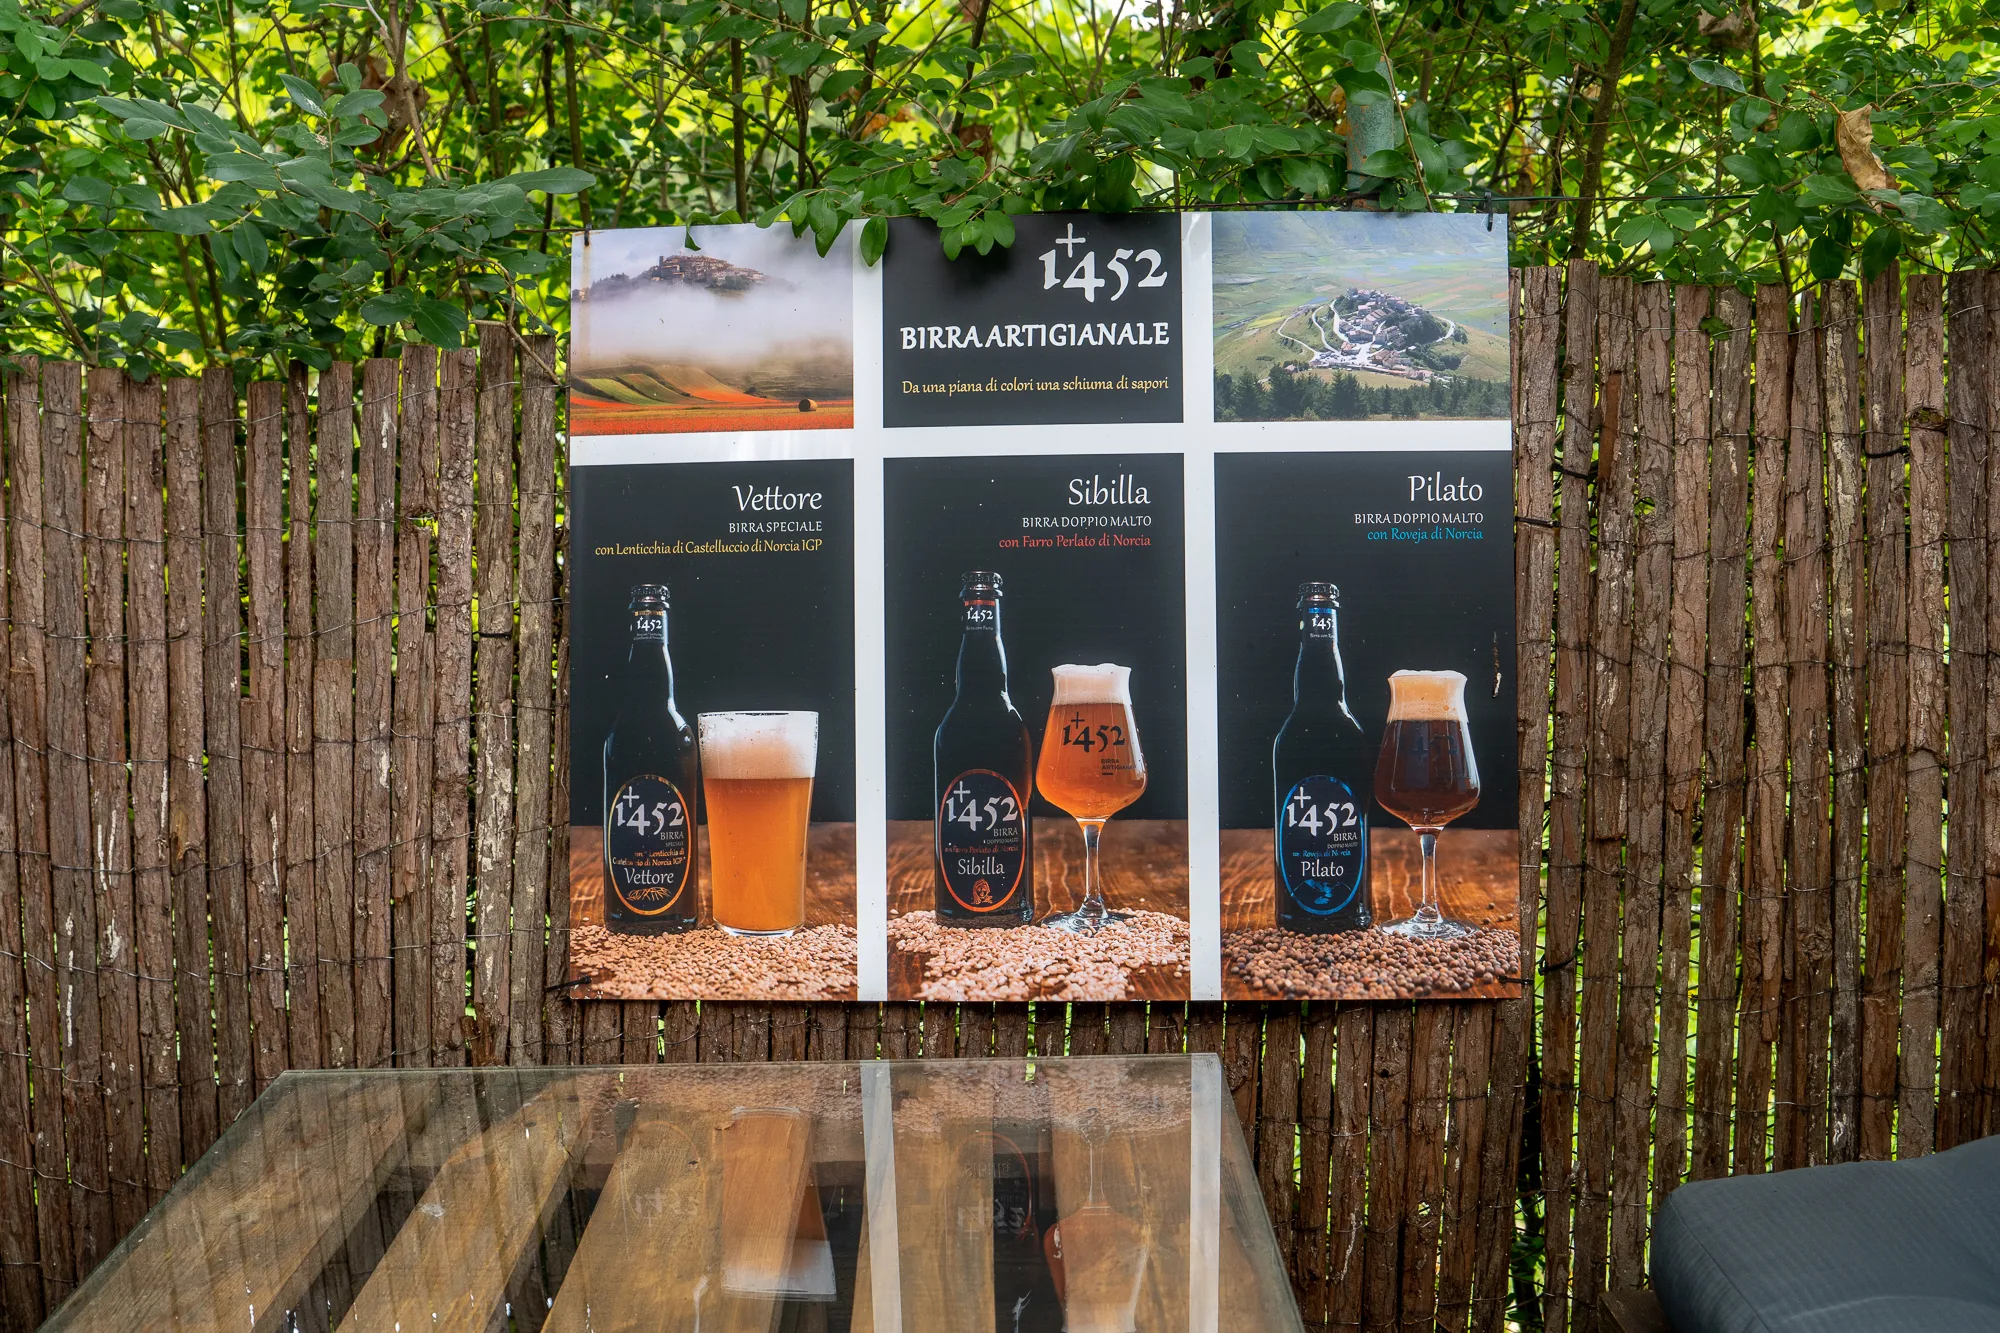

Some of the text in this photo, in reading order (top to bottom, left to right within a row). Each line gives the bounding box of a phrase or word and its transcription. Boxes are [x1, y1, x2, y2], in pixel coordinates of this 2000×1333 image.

[1038, 248, 1168, 303] 1452
[900, 322, 1170, 350] BIRRA ARTIGIANALE
[902, 375, 1169, 396] Da una piana di colori una schiuma di sapori
[1068, 474, 1151, 505] Sibilla
[1407, 471, 1483, 502] Pilato
[732, 484, 822, 511] Vettore
[729, 520, 823, 533] BIRRA SPECIALE
[1022, 515, 1152, 528] BIRRA DOPPIO MALTO
[1354, 512, 1484, 524] BIRRA DOPPIO MALTO
[999, 533, 1151, 548] con Farro Perlato di Norcia
[1367, 525, 1483, 544] con Roveja di Norcia
[595, 538, 823, 556] con Lenticchia di Castelluccio di Norcia IGP
[967, 609, 994, 622] 1452
[1311, 617, 1336, 630] 145
[637, 619, 662, 631] 1452
[1063, 724, 1125, 752] 1452
[615, 802, 684, 836] 1452
[945, 796, 1018, 832] 1452
[1286, 802, 1358, 836] 1452
[660, 831, 685, 841] BIRRA
[993, 827, 1018, 837] BIRRA
[1333, 832, 1358, 842] BIRRA
[957, 857, 1005, 875] Sibilla
[1300, 859, 1344, 877] Pilato
[624, 867, 674, 885] Vettore
